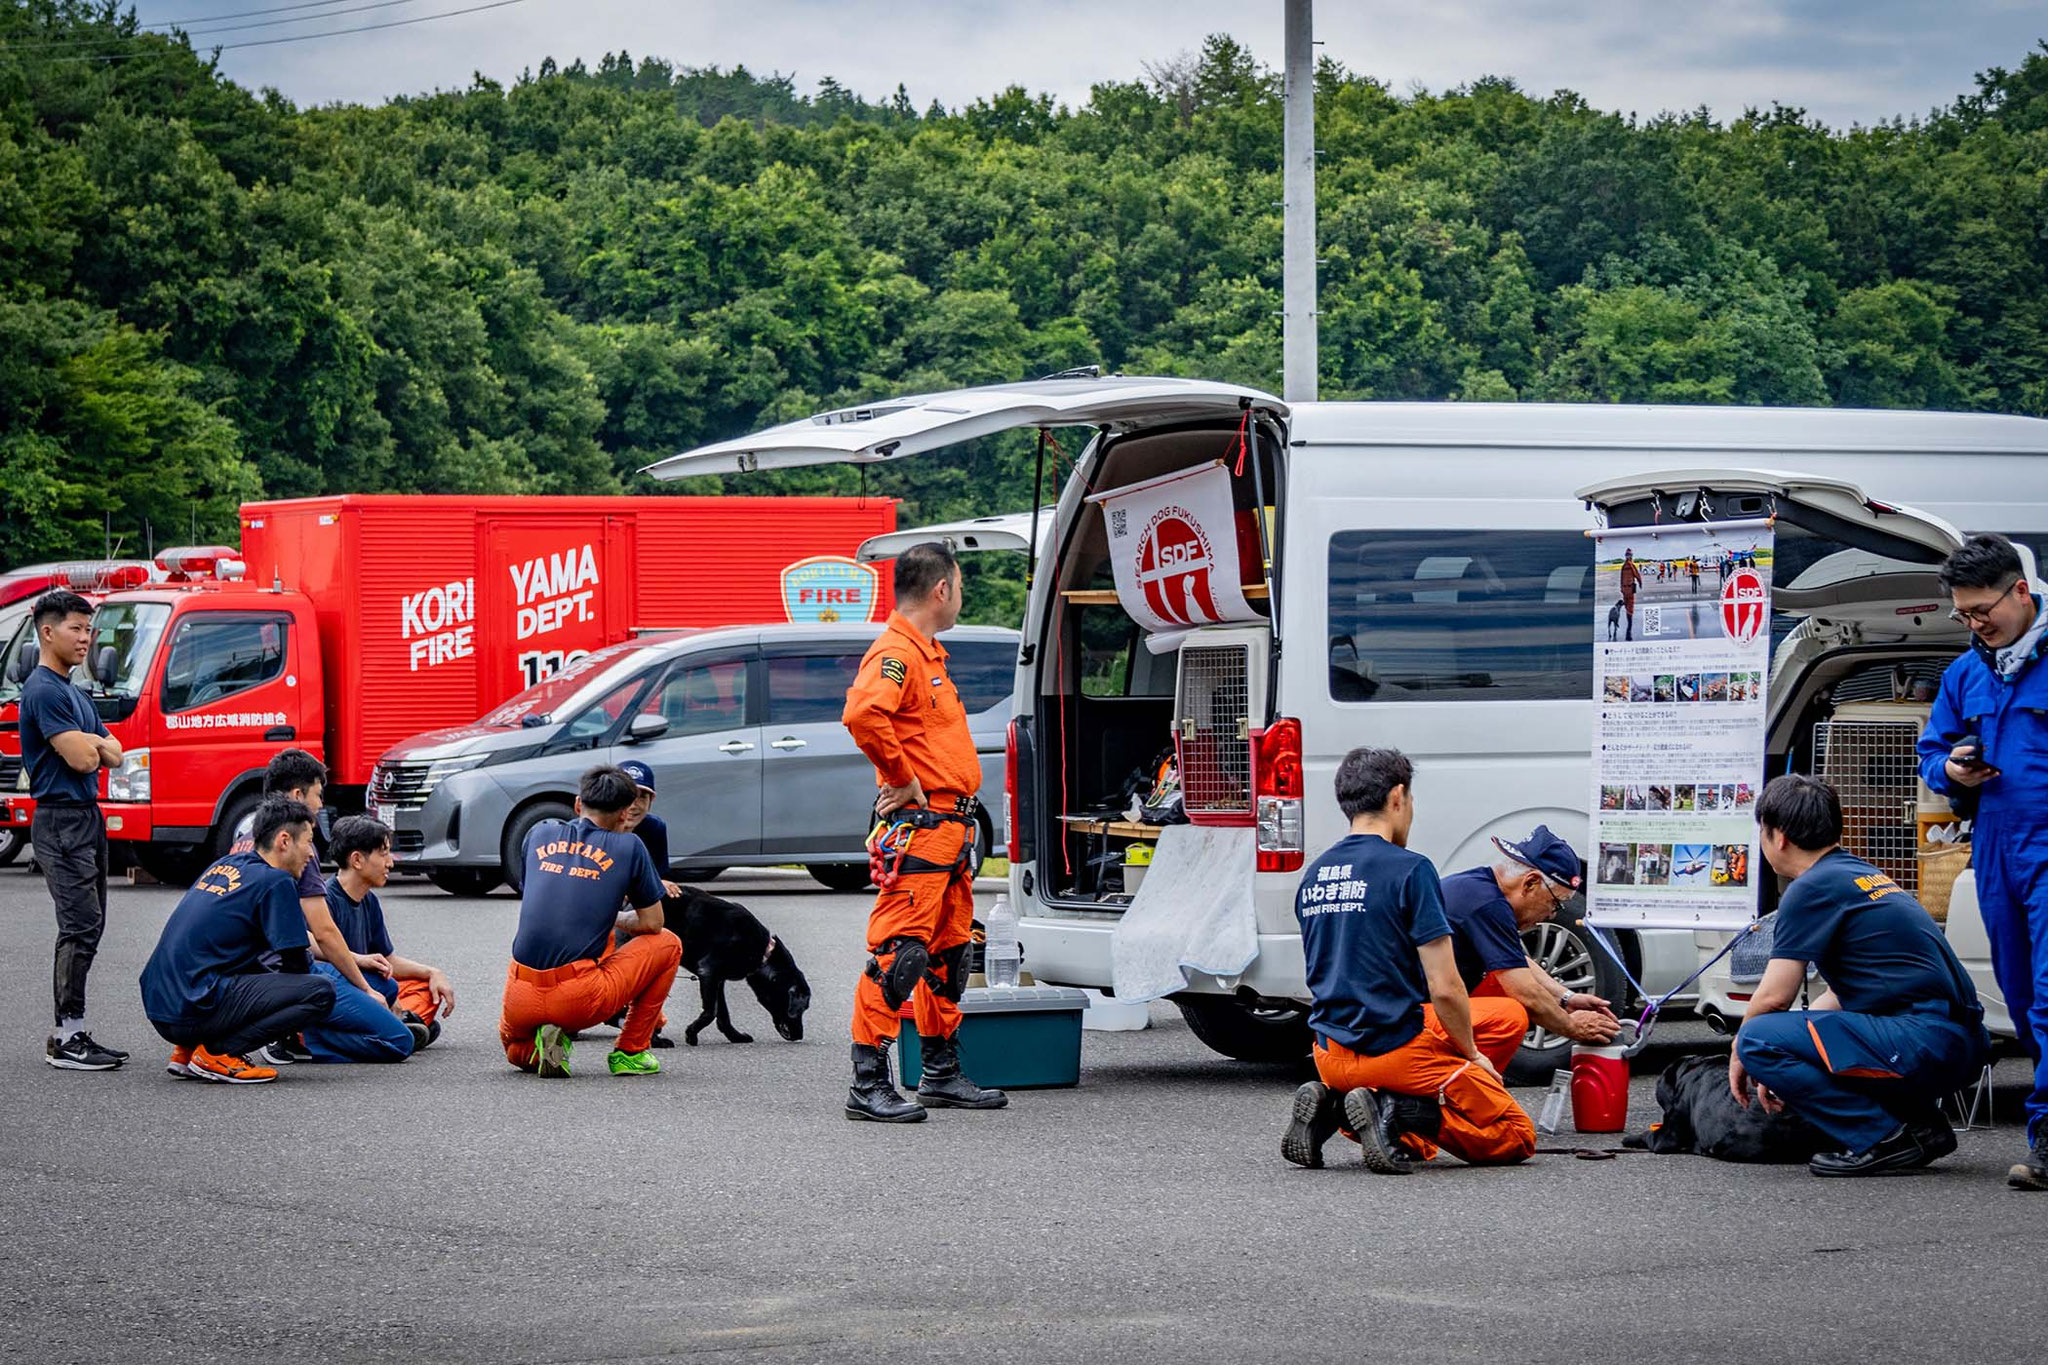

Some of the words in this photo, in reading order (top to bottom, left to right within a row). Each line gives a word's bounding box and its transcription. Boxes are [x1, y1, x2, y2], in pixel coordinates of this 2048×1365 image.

[1135, 523, 1151, 590] SEARCH
[1151, 506, 1171, 526] DOG
[1171, 505, 1215, 574] FUKUSHIMA
[1160, 539, 1199, 568] SDF
[510, 544, 600, 606] YAMA
[799, 588, 862, 604] FIRE
[1738, 587, 1761, 598] SDF
[401, 577, 475, 638] KORI
[517, 590, 595, 641] DEPT.
[409, 625, 475, 671] FIRE
[166, 712, 287, 729] 郡山地方広域消防組合
[536, 841, 614, 871] KORIYAMA
[539, 861, 564, 874] FIRE
[568, 867, 601, 880] DEPT.
[1317, 864, 1353, 881] 福島県
[1302, 880, 1368, 904] いわき消防
[1321, 903, 1341, 914] FIRE
[1341, 902, 1366, 913] DEPT.
